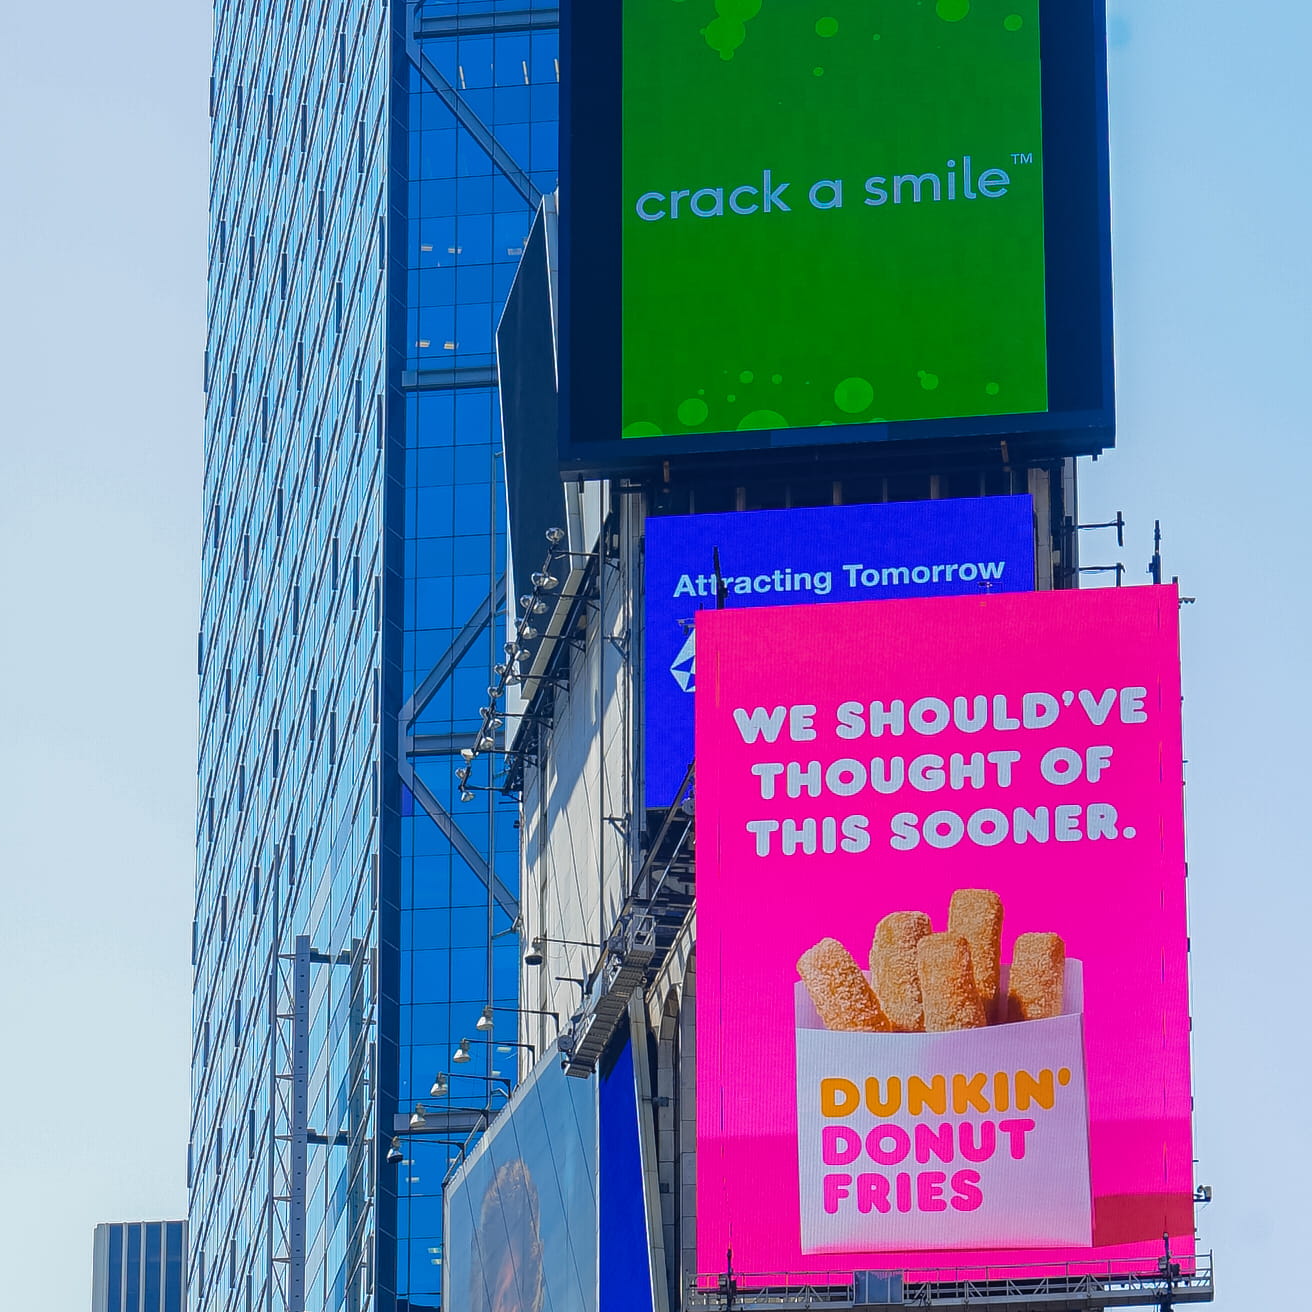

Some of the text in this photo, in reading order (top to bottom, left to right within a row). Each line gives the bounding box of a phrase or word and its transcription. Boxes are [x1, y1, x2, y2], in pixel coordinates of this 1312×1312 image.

[635, 169, 791, 221] crack
[808, 178, 843, 208] a
[672, 558, 1006, 597] Attracting Tomorrow
[733, 704, 817, 744] WE
[751, 745, 1114, 800] THOUGHT OF
[746, 803, 1137, 858] THIS SOONER.
[820, 1067, 1071, 1119] DUNKIN'
[821, 1118, 1035, 1167] DONUT
[822, 1171, 984, 1214] FRIES
